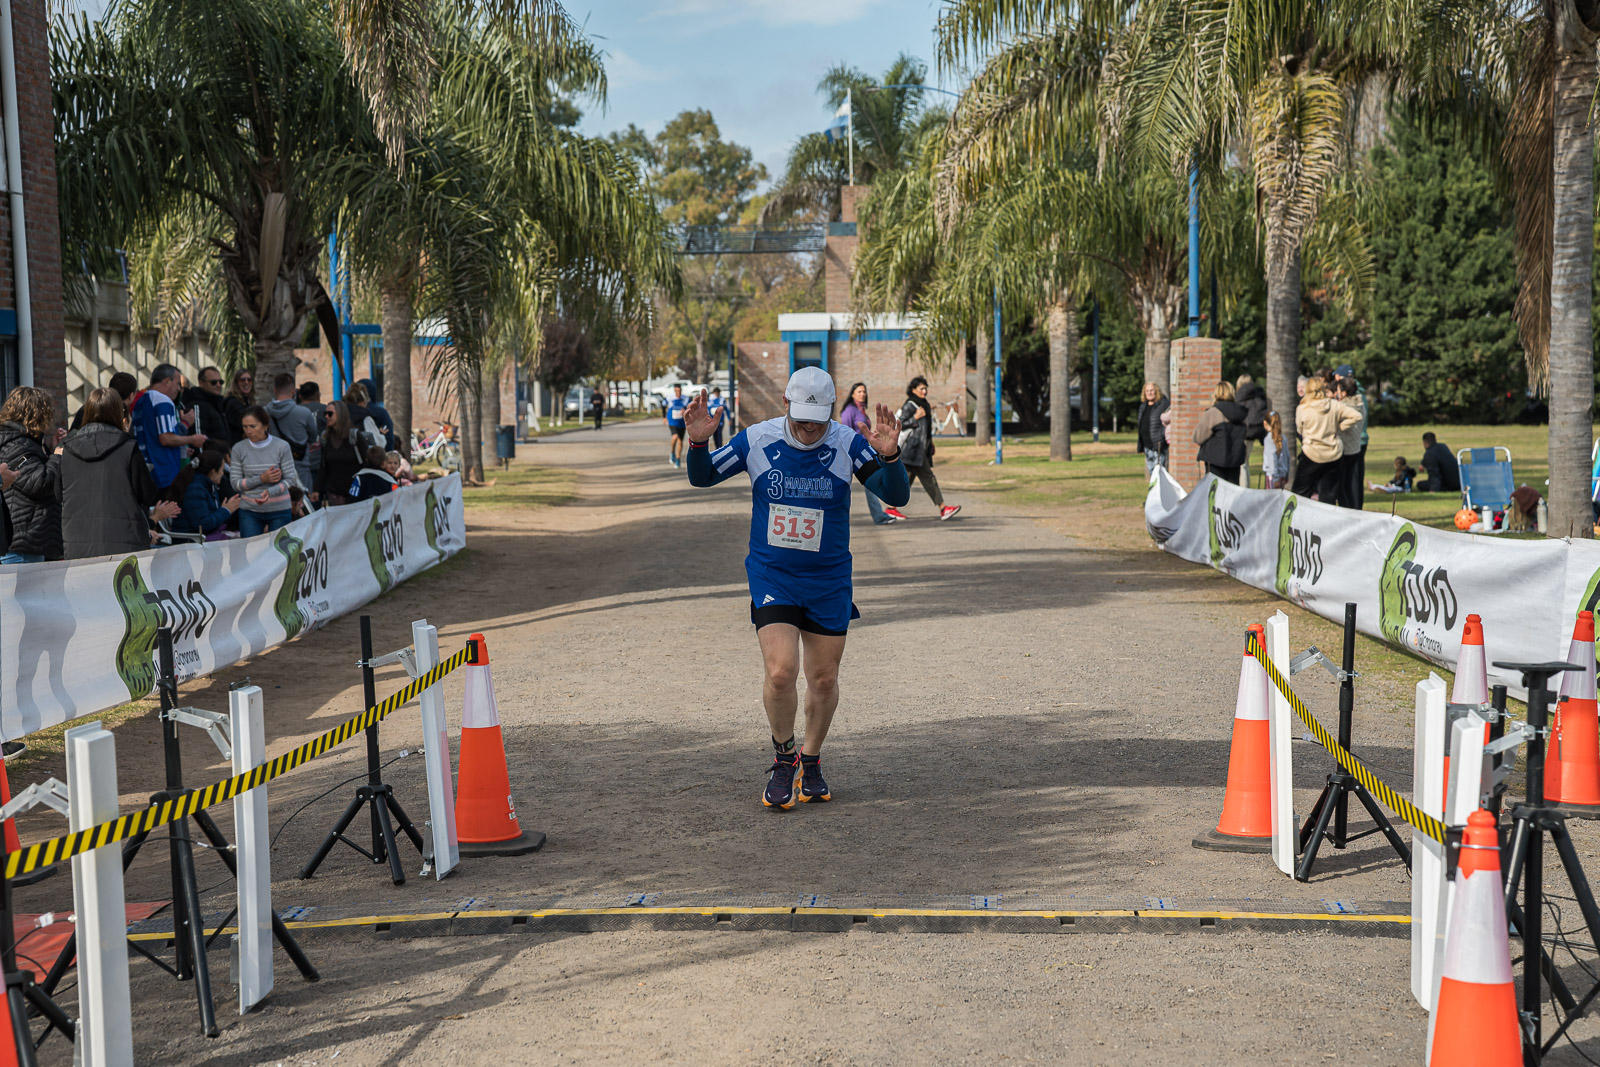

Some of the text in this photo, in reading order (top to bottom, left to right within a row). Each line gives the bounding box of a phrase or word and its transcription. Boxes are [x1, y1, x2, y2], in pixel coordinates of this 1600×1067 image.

[767, 469, 783, 500] 3
[784, 476, 833, 491] MARATÓN
[772, 515, 816, 540] 513
